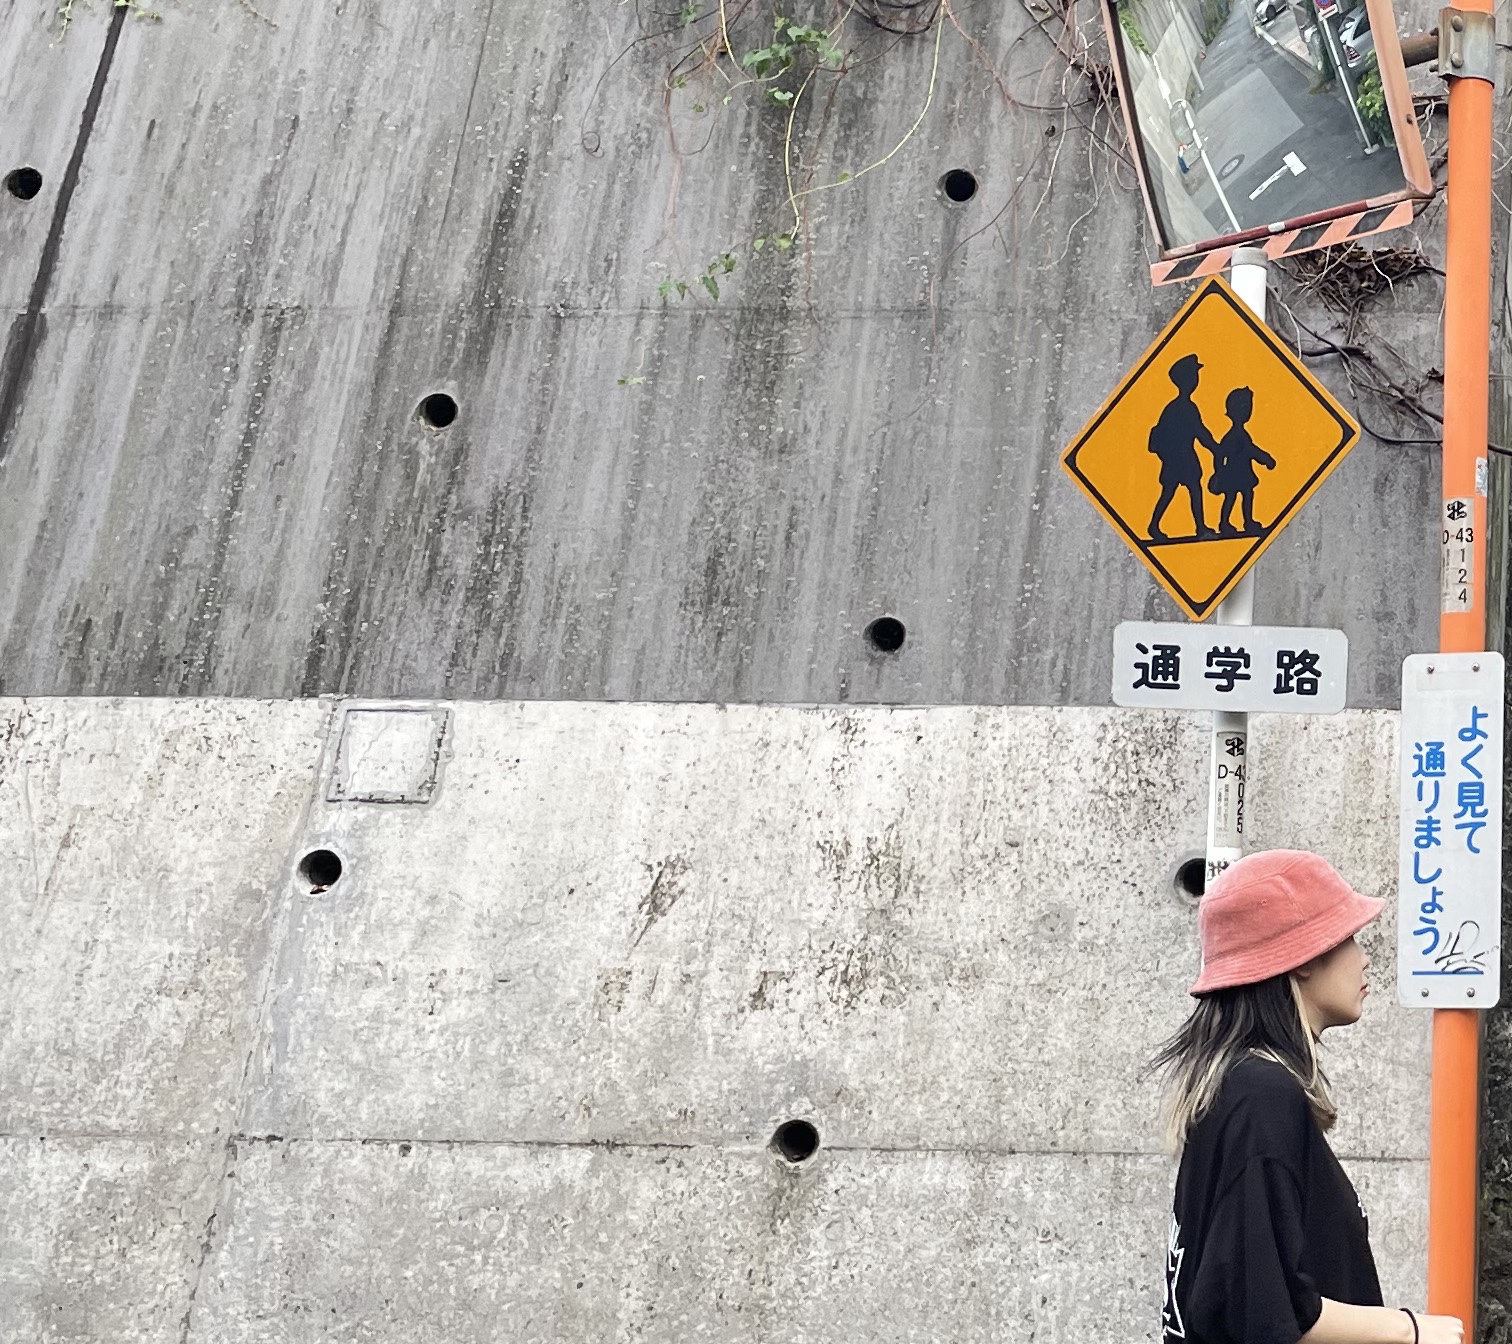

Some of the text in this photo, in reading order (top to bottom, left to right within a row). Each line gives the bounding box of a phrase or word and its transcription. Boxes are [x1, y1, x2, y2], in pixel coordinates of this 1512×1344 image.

[1132, 642, 1322, 696] 通学路
[1411, 741, 1446, 956] 通りましょう
[1453, 705, 1489, 854] よく見て
